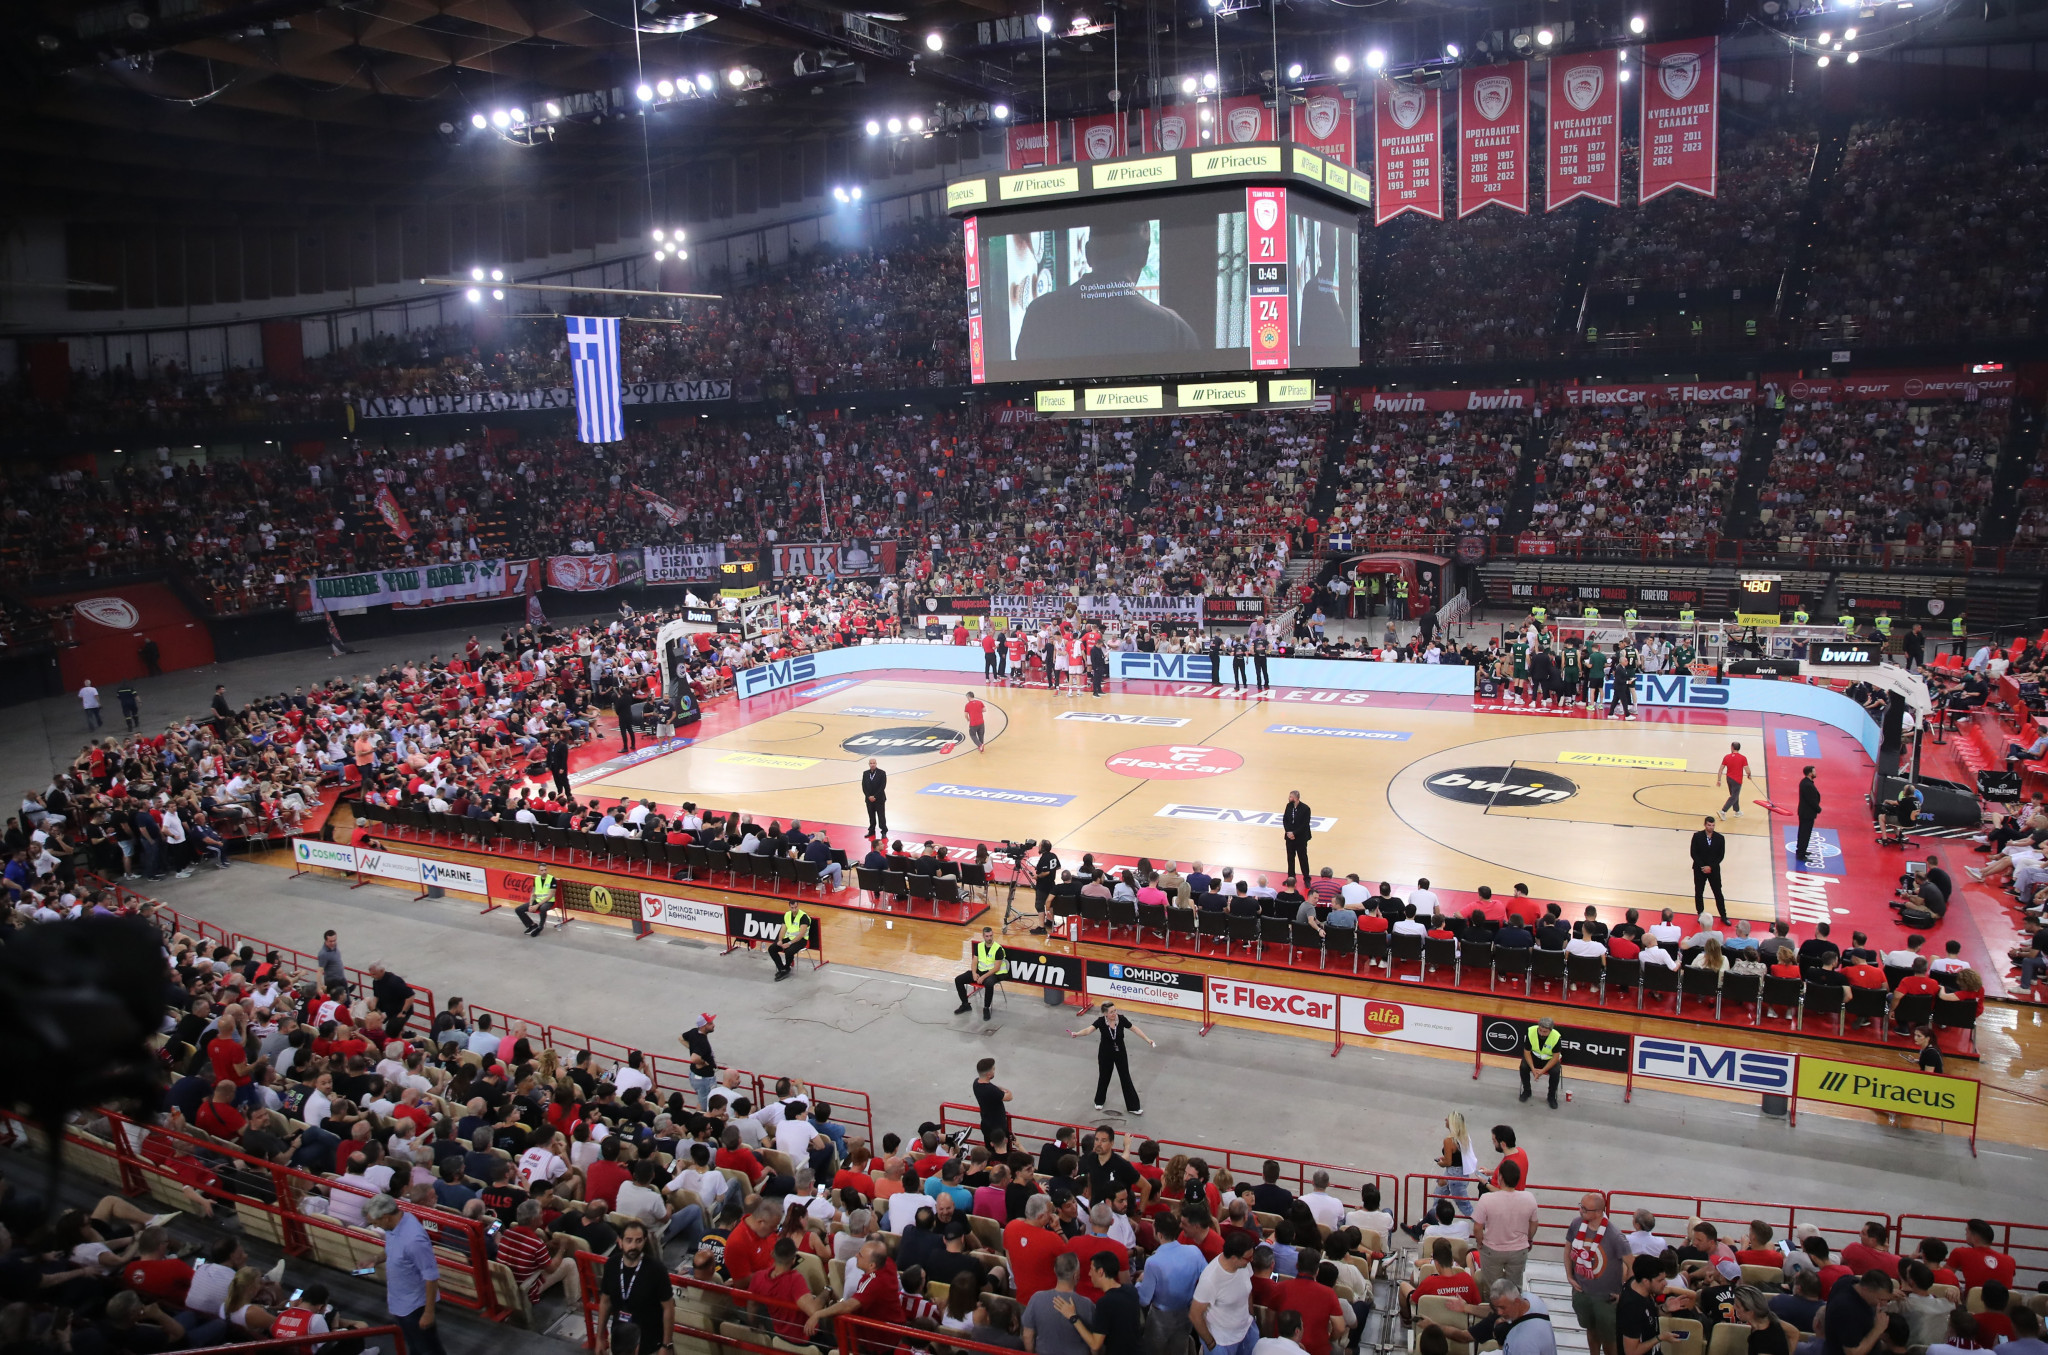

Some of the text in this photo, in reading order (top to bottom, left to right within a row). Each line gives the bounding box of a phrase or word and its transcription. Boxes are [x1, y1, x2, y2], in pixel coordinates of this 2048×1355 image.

[1683, 131, 1702, 141] 2011
[1016, 135, 1049, 151] SPANOULIS
[1560, 142, 1606, 154] 1976 1977
[1653, 142, 1702, 155] 2022 2023
[1221, 154, 1267, 169] Piraeus
[1471, 150, 1514, 162] 1996 1997
[1560, 155, 1578, 165] 1978
[1653, 156, 1673, 166] 2024
[1387, 160, 1404, 170] 1949
[1471, 161, 1514, 173] 2012 2015
[1559, 163, 1605, 176] 1994 1997
[1120, 165, 1163, 180] Piraeus
[1387, 168, 1429, 180] 1976 1978
[1471, 171, 1515, 183] 2016 2022
[1026, 176, 1066, 191] Piraeus
[1387, 178, 1429, 190] 1993 1994
[1573, 175, 1592, 185] 2002
[1483, 183, 1501, 192] 2023
[1400, 190, 1417, 199] 1995
[1260, 236, 1275, 257] 21
[1258, 268, 1278, 280] 0:49
[1259, 301, 1279, 321] 24
[972, 321, 980, 339] 24
[1287, 384, 1308, 396] Piraeus
[1809, 384, 1890, 394] NER QUIT
[1977, 380, 2013, 389] QUIT
[1108, 392, 1149, 405] Piraeus
[1206, 387, 1247, 400] Piraeus
[1467, 389, 1523, 410] bwin
[1581, 388, 1647, 403] FlexCar
[1683, 385, 1752, 401] FlexCar
[1044, 395, 1066, 407] Piraeus
[1373, 392, 1426, 412] bwin
[662, 556, 692, 567] ΕΙΣΑΙ
[316, 563, 478, 599] WHERE YOU ARE?
[510, 562, 529, 594] 7
[1512, 585, 1521, 595] WE
[1521, 585, 1533, 596] ARE
[1578, 587, 1591, 598] THIS
[1591, 588, 1600, 598] IS
[1641, 589, 1668, 601] FOREVER
[1235, 600, 1245, 611] WE
[1245, 600, 1262, 612] FIGHT
[687, 610, 713, 622] bwin
[1751, 617, 1778, 625] Piraeus
[1820, 647, 1869, 663] bwin
[1121, 652, 1213, 683] FMS
[1755, 666, 1777, 674] bwin
[745, 655, 816, 694] FMS
[1064, 712, 1183, 726] FMS
[1271, 724, 1398, 741] Stoiximan
[1107, 757, 1233, 775] FlexCar
[1596, 755, 1675, 767] Piraeus
[927, 784, 1056, 804] Stoiximan
[1431, 773, 1573, 803] bwin
[1987, 786, 2018, 796] SPALDING
[312, 848, 352, 863] COSMOTE
[437, 867, 472, 882] MARINE
[595, 891, 608, 905] M
[667, 904, 693, 914] ΟΜΙΛΟΣ
[668, 911, 697, 921] ΑΘΗΝΩΝ
[743, 913, 783, 941] bw
[1124, 967, 1179, 985] ΟΜΗΡΟΣ
[1109, 982, 1179, 1001] AegeanCollege
[1233, 986, 1333, 1020] FlexCar
[1367, 1007, 1400, 1025] alfa
[1488, 1031, 1516, 1041] GSA
[1586, 1043, 1627, 1057] QUIT
[1638, 1039, 1790, 1088] FMS
[1851, 1073, 1956, 1111] Piraeus
[1437, 1286, 1469, 1295] OLYMPIACOS
[1718, 1303, 1736, 1323] 3
